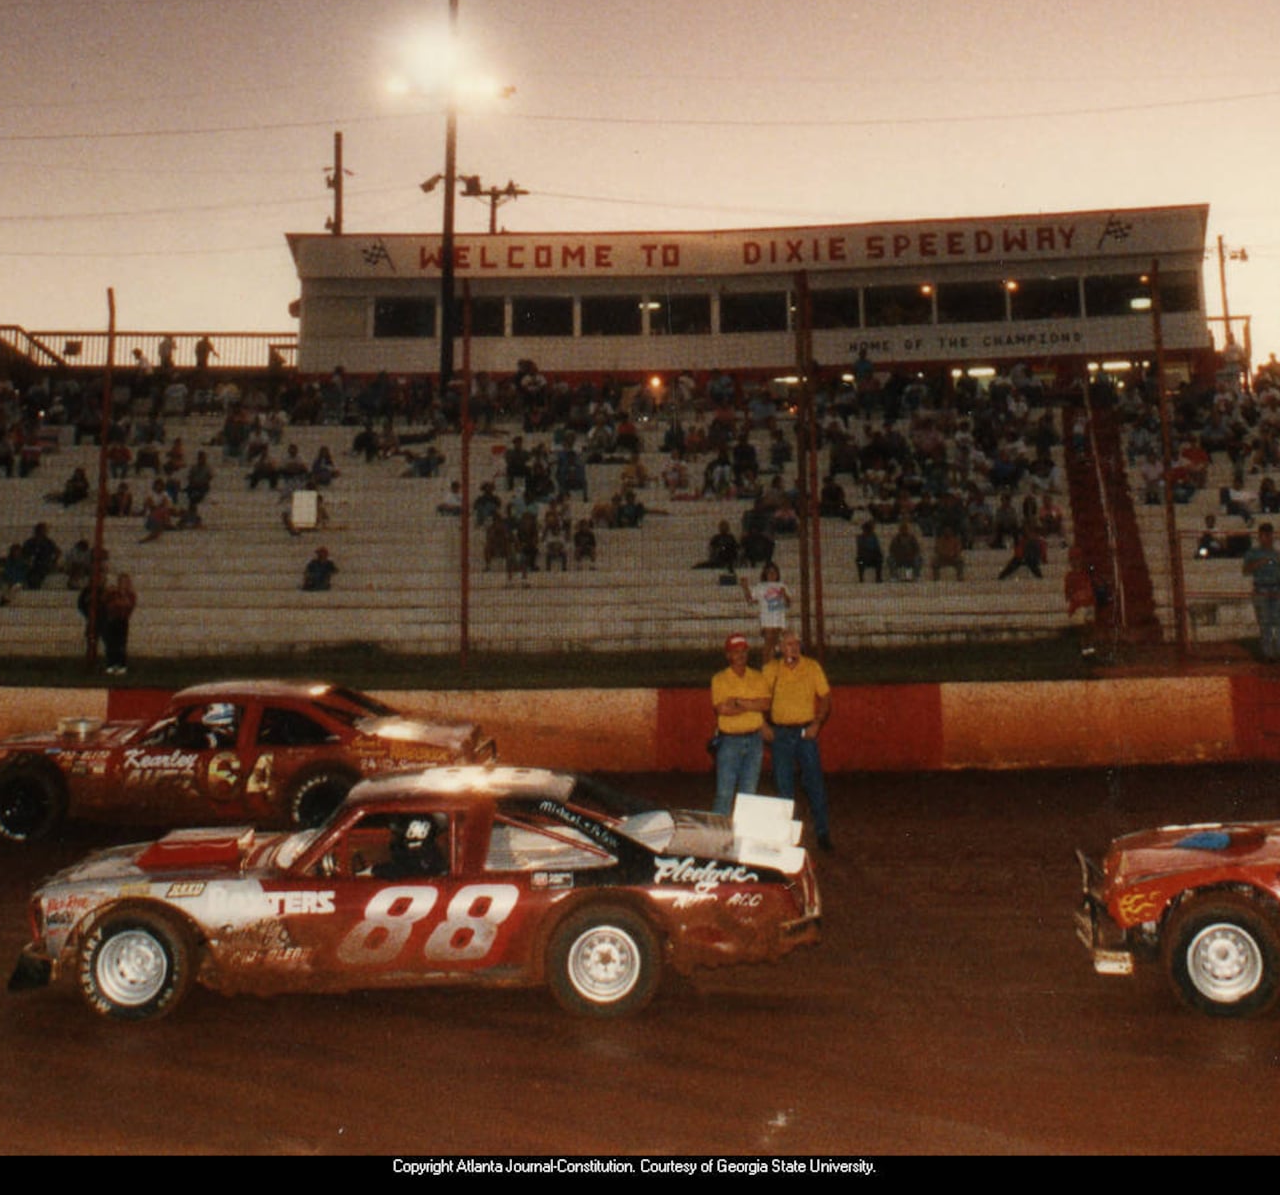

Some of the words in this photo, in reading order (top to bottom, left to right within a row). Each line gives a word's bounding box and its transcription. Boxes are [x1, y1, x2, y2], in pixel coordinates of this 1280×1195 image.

[419, 244, 613, 269] WELCOME
[641, 244, 680, 268] TO
[743, 236, 846, 266] DIXIE
[865, 225, 1076, 260] SPEEDWAY
[849, 340, 889, 353] HOME
[904, 340, 922, 351] OF
[939, 336, 969, 349] THE
[982, 331, 1083, 348] CHAMPIONS
[337, 883, 520, 965] 88
